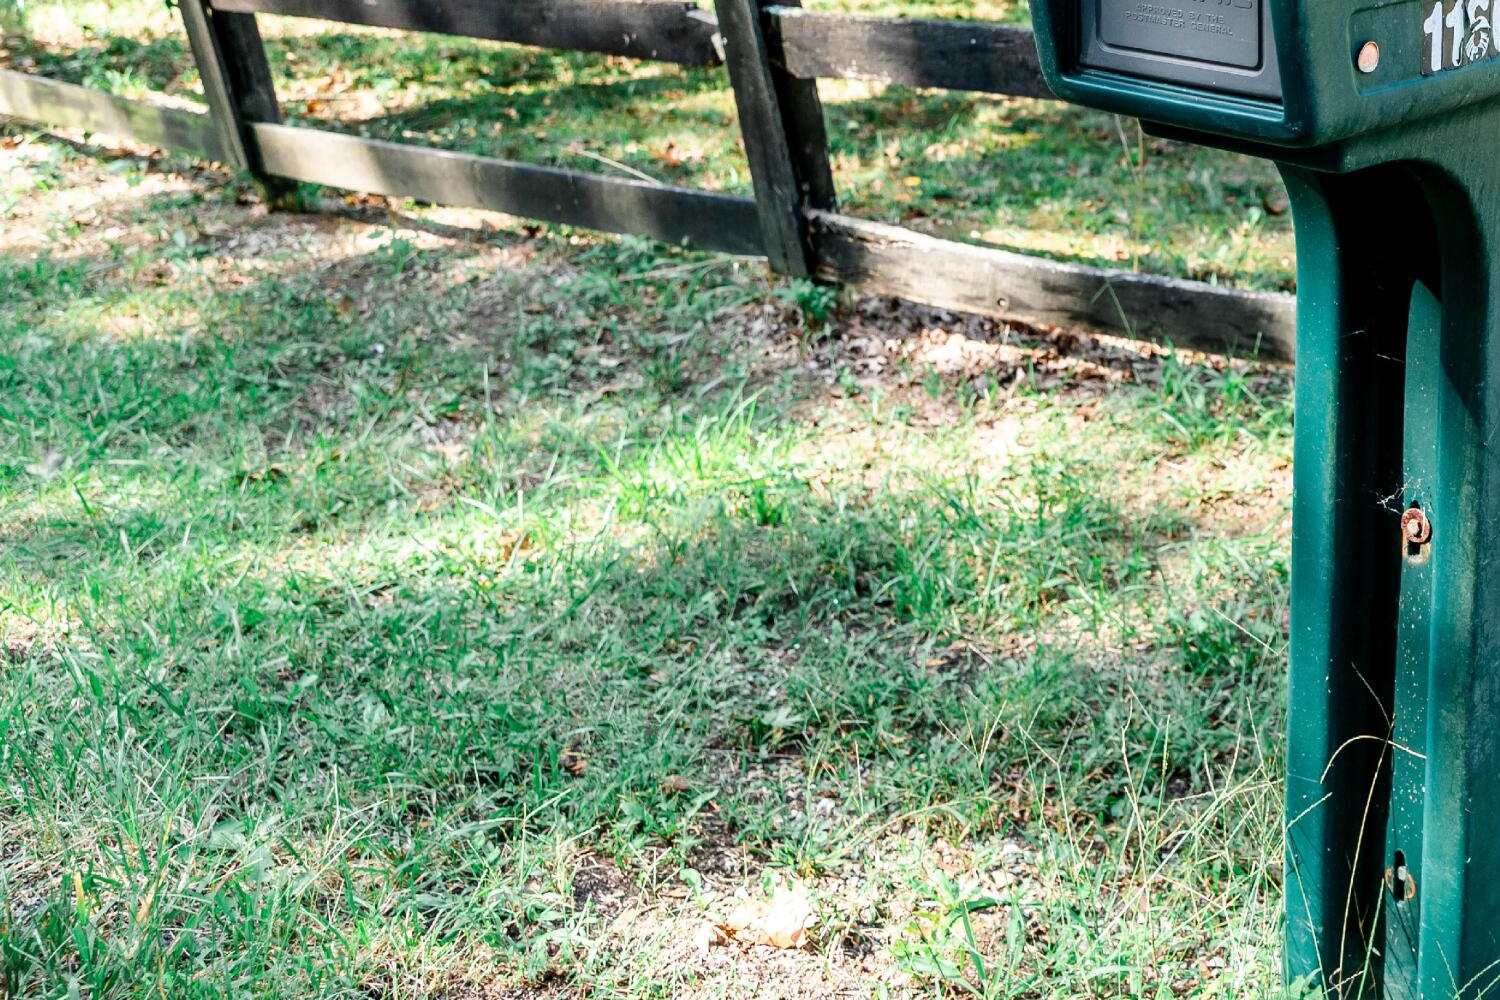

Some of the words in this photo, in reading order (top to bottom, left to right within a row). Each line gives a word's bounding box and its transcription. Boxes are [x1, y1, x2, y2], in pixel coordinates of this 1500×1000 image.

[1124, 10, 1186, 29] POSTMASTER
[1190, 21, 1234, 37] GENERAL
[1135, 3, 1184, 19] APPROVED
[1188, 11, 1202, 21] BY
[1205, 13, 1225, 25] THE
